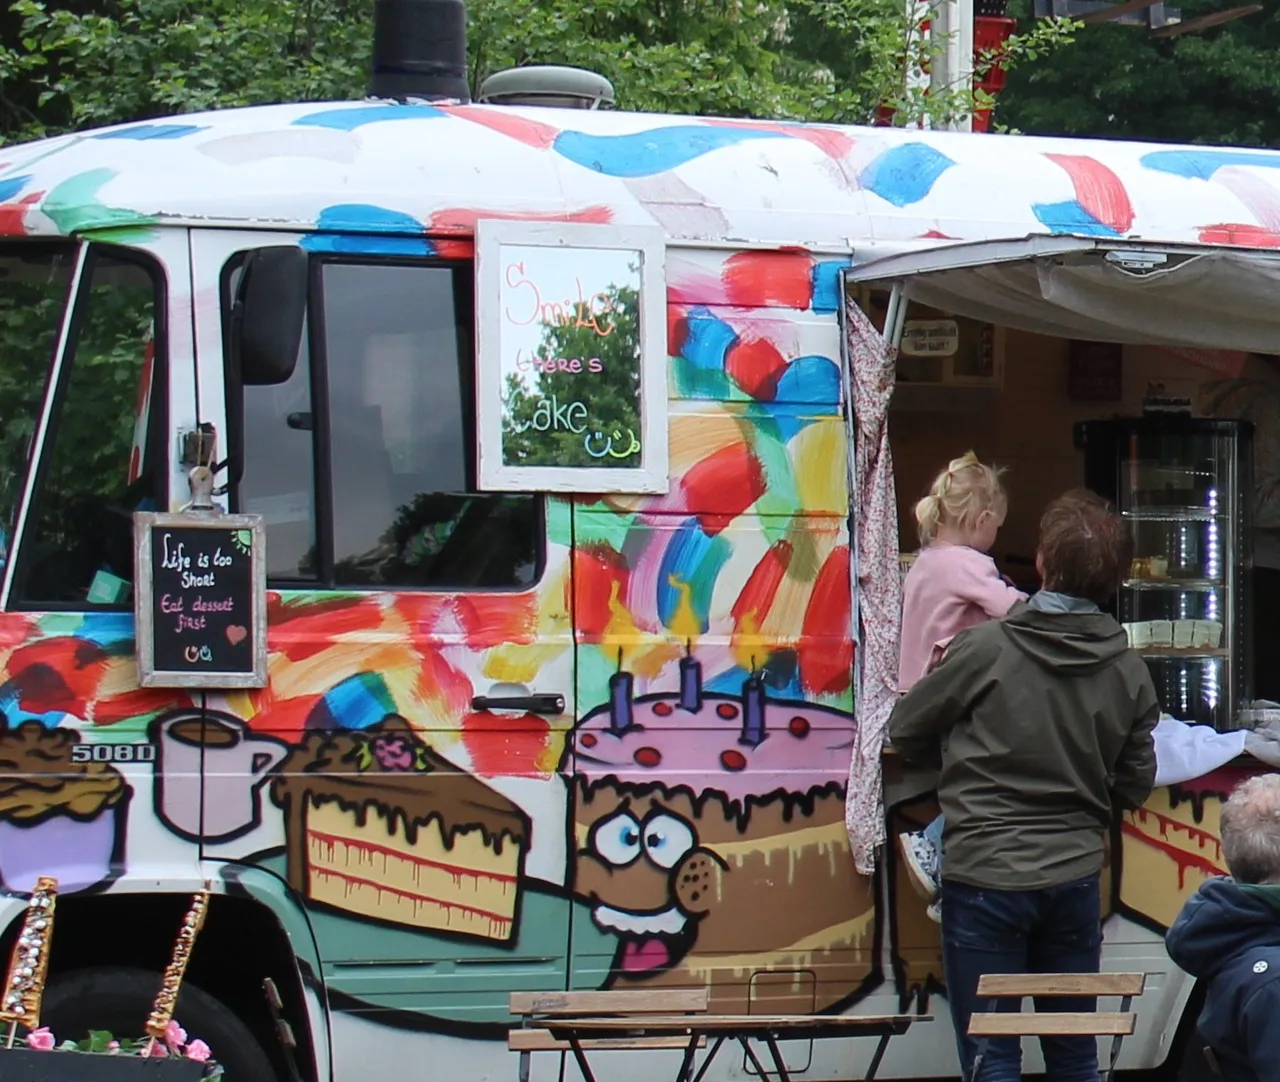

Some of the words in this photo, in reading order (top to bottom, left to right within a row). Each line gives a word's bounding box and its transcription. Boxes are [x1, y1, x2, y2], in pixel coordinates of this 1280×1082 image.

[506, 262, 615, 336] Smile
[161, 533, 190, 572] Life
[198, 552, 209, 568] is
[213, 547, 233, 567] too
[161, 594, 184, 613] Eat
[72, 745, 156, 762] 508D
